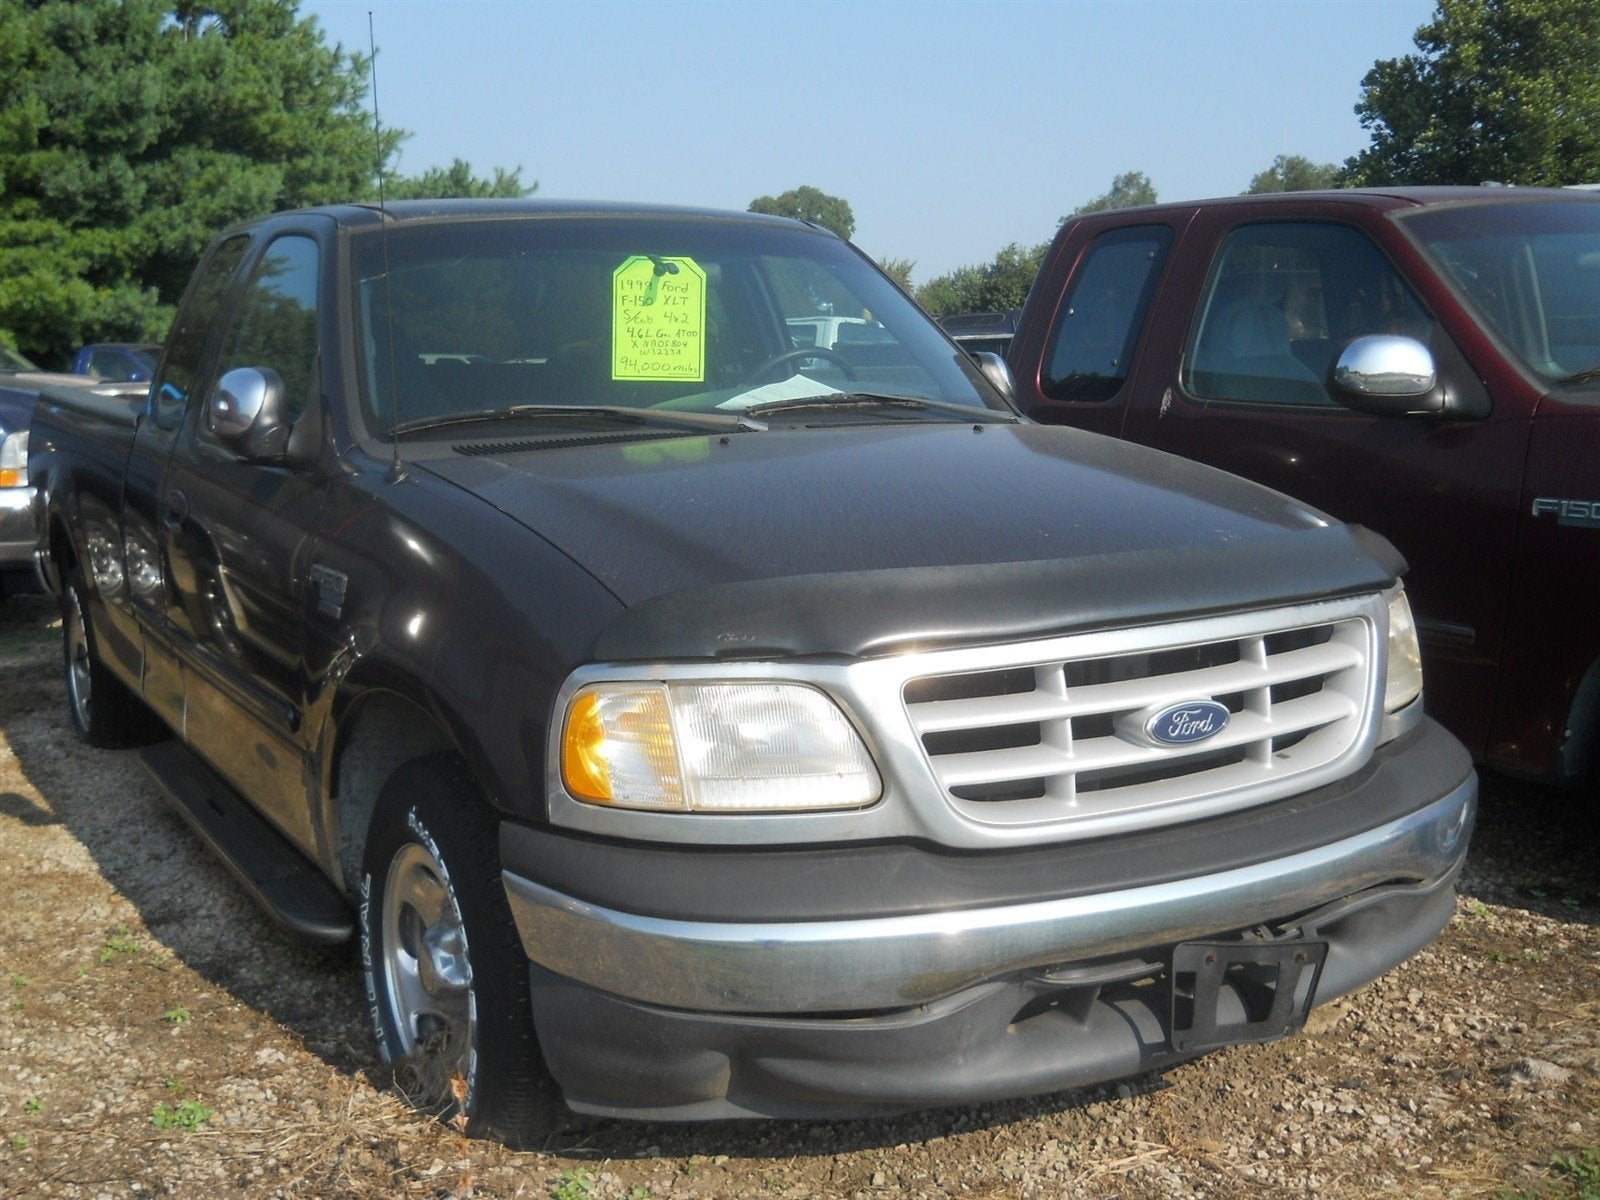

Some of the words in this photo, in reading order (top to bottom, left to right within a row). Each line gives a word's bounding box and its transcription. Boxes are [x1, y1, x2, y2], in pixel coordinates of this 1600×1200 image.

[620, 279, 653, 291] 1999
[661, 280, 689, 293] Ford
[621, 294, 655, 307] F-150
[663, 294, 690, 306] XLT
[620, 355, 671, 374] 94,000
[1168, 708, 1214, 737] Ford
